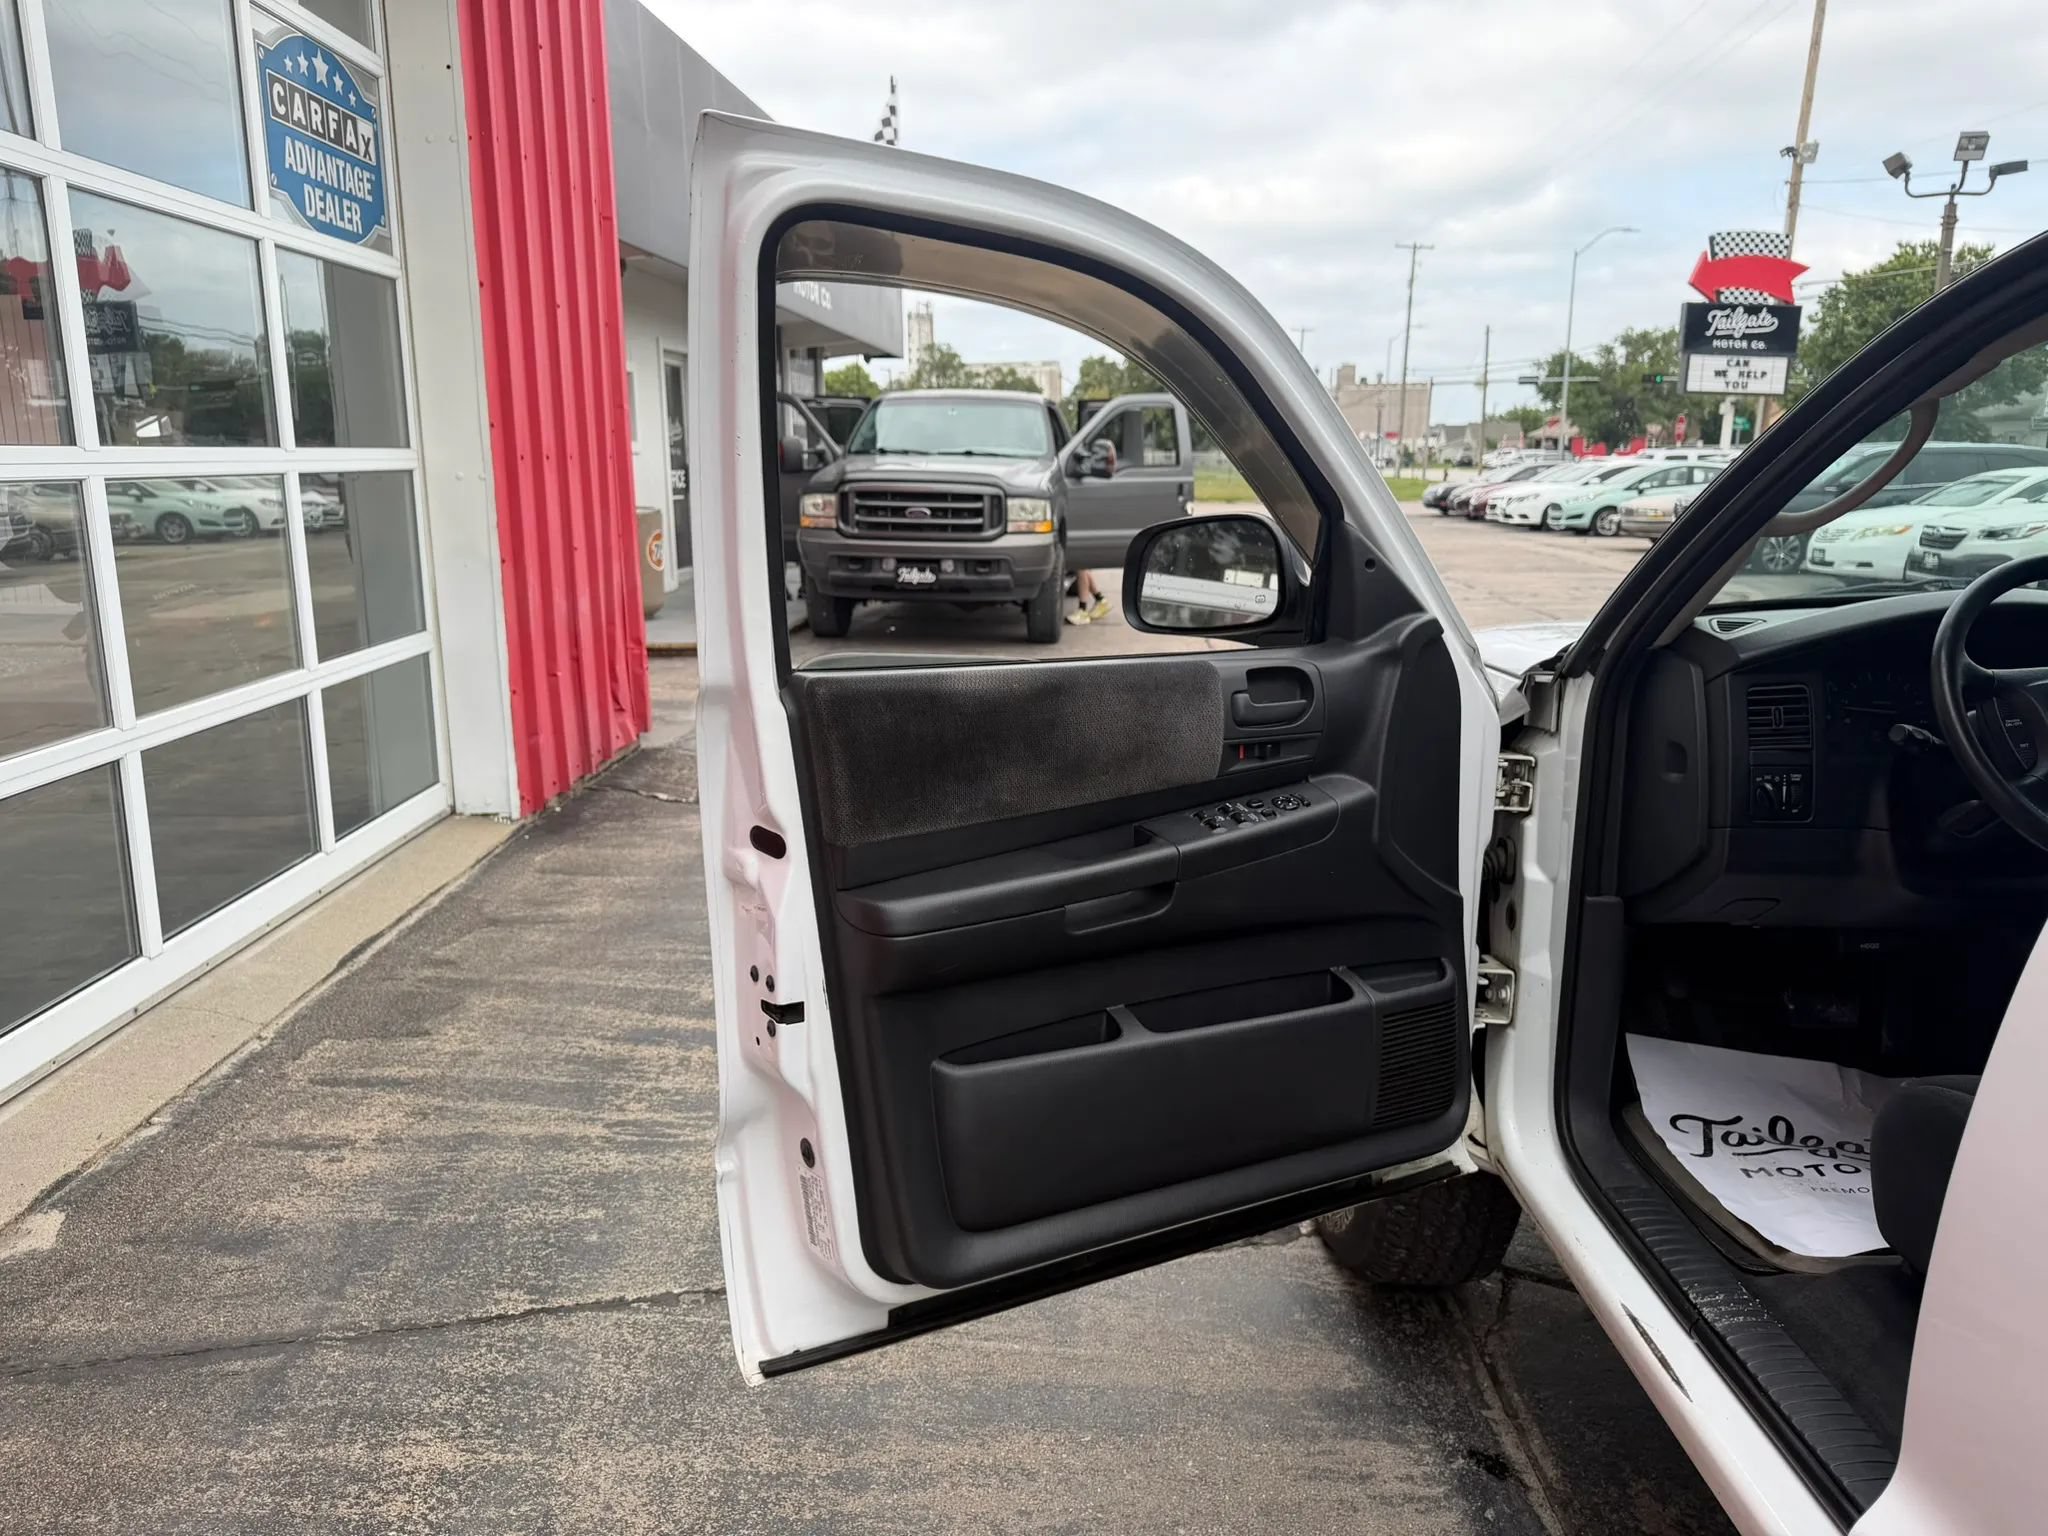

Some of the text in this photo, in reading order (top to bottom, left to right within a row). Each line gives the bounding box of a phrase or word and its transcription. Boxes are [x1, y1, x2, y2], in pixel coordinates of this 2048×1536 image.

[271, 82, 373, 162] CARFAX
[285, 136, 374, 202] ADVANTAGE
[303, 183, 363, 234] DEALER
[1704, 306, 1779, 338] Tailgate
[1712, 339, 1748, 350] MOTOR
[1726, 358, 1750, 367] CAN
[1713, 370, 1768, 380] WE HELP
[1724, 381, 1749, 389] YOU
